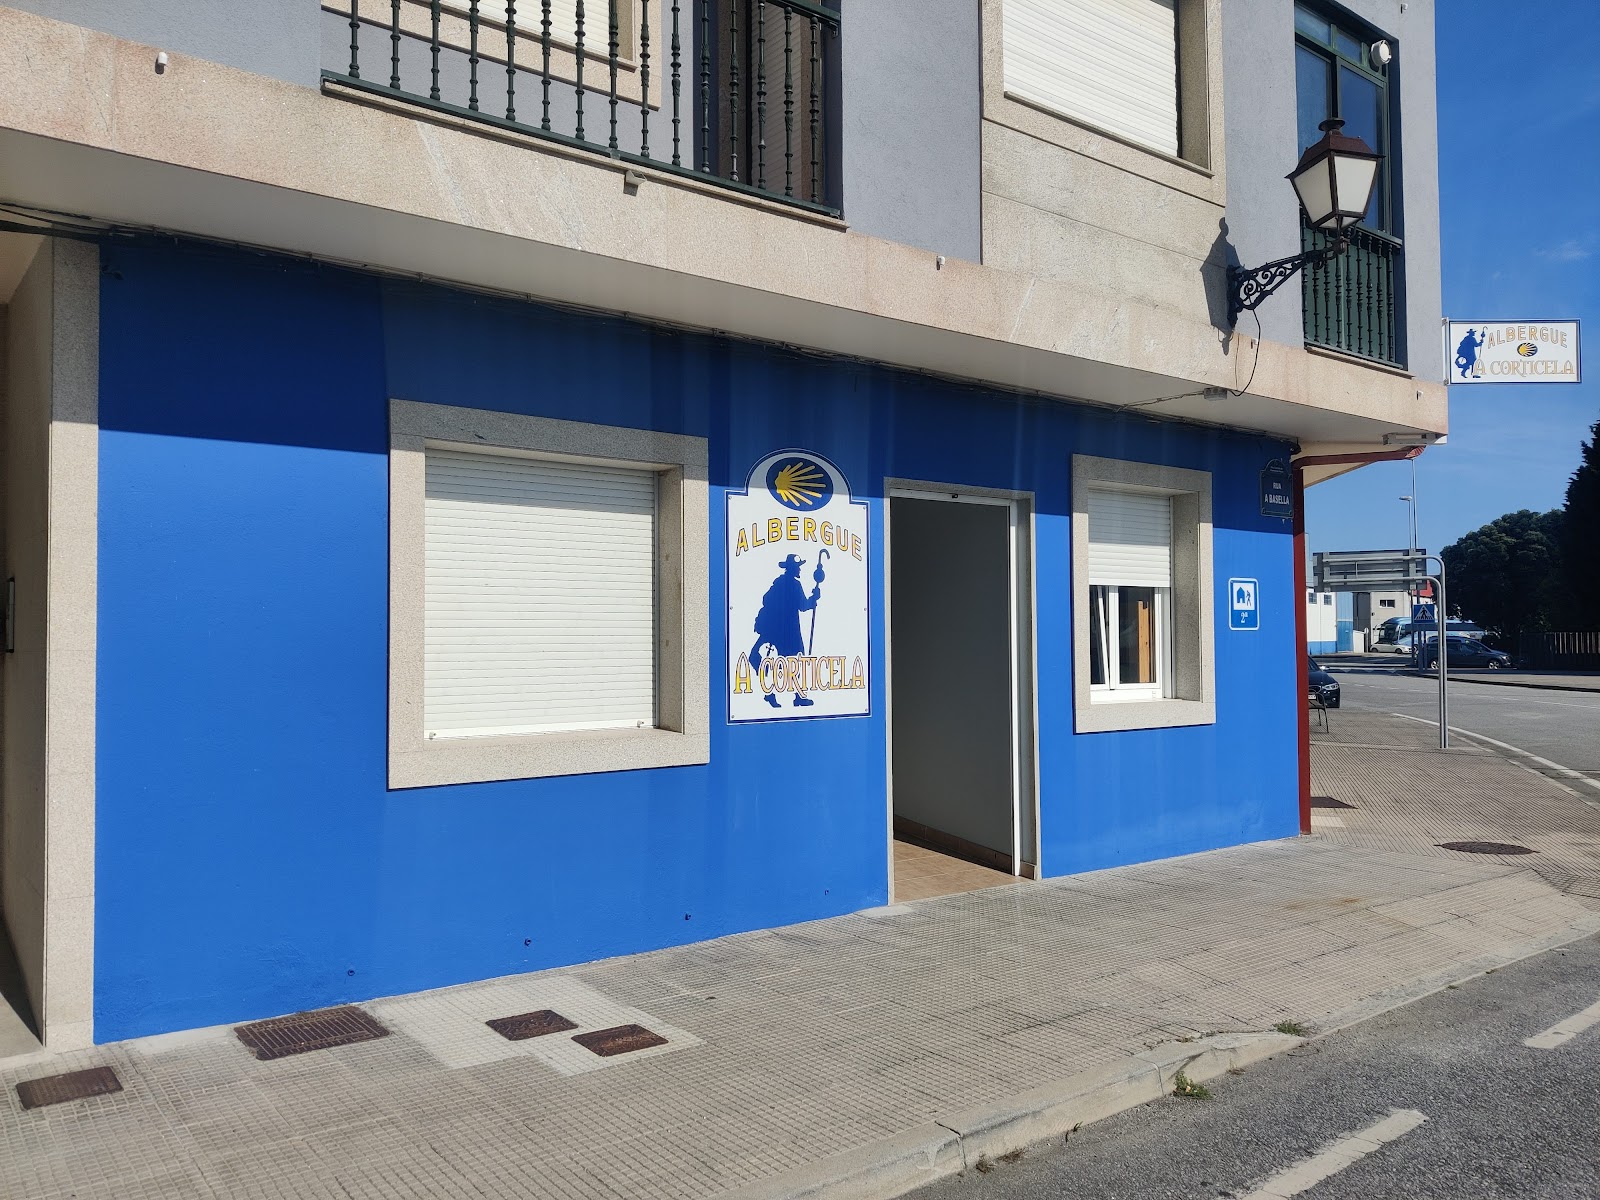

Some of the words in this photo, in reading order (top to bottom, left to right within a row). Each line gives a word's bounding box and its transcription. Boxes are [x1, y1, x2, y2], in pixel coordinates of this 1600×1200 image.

[1488, 326, 1567, 349] ALBERGUE
[1473, 359, 1486, 375] A
[1490, 359, 1575, 377] CORTICELA
[1264, 493, 1269, 503] A
[1269, 494, 1290, 505] BASELLA
[736, 516, 862, 561] ALBERGUE
[733, 652, 753, 694] A
[760, 652, 865, 698] CORTICELA
